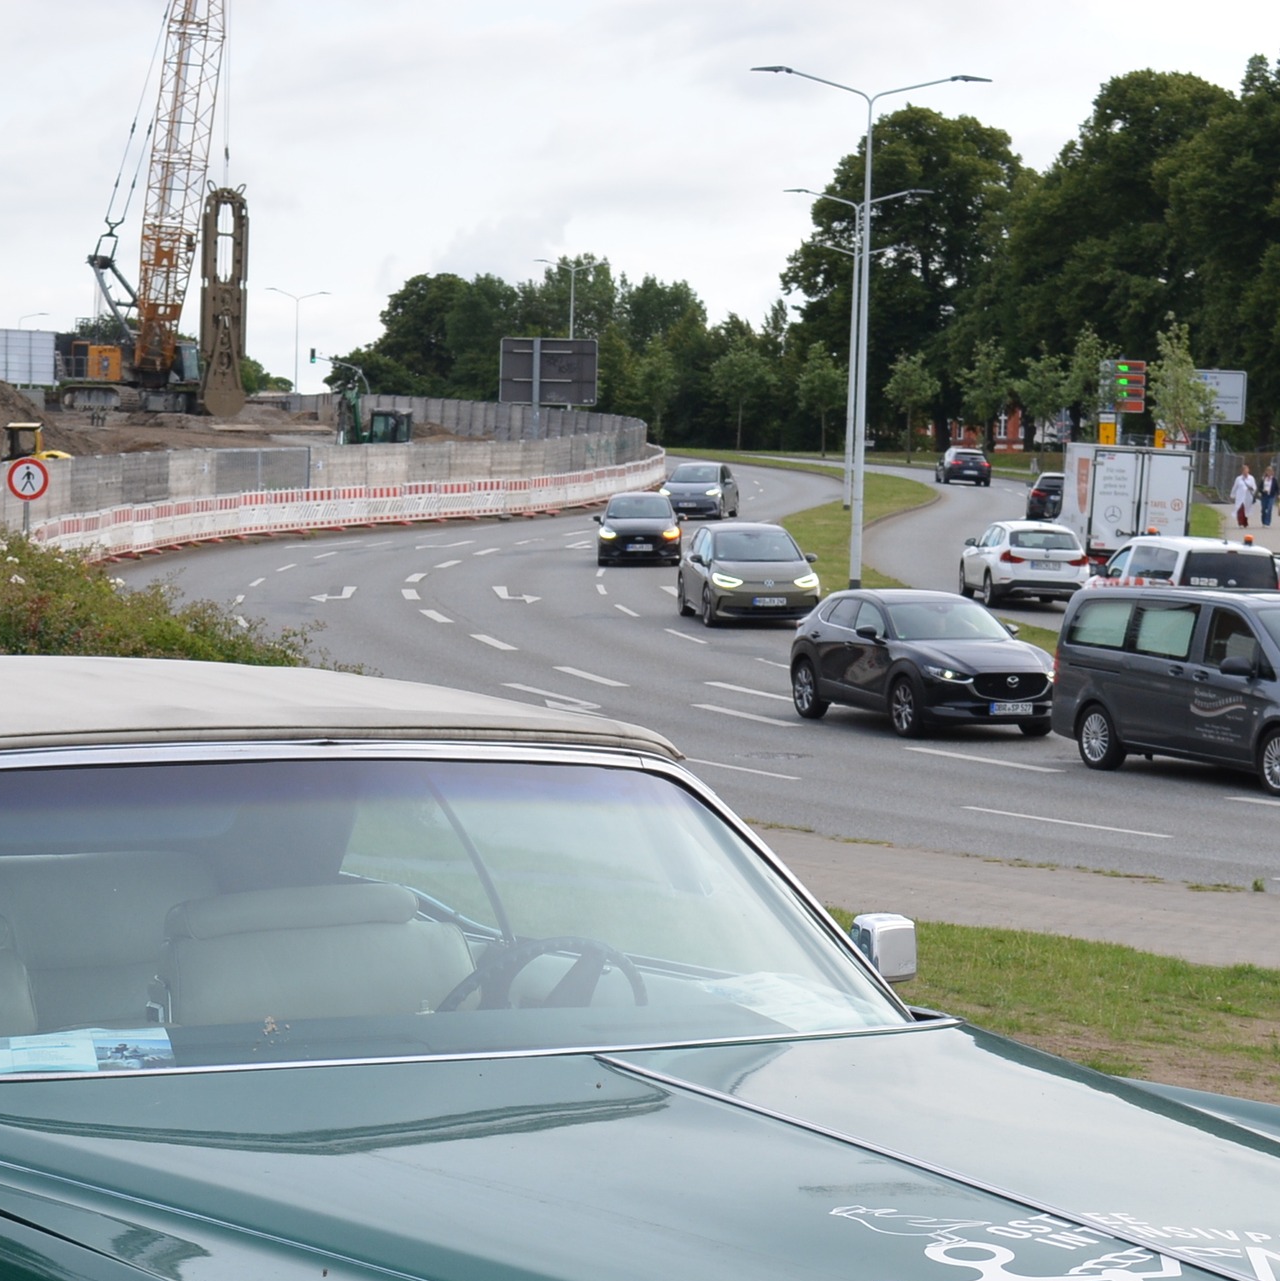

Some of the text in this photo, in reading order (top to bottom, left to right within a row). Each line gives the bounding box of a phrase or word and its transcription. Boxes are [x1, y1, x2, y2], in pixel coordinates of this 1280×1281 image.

[1150, 500, 1168, 509] TAFEL
[1020, 703, 1032, 712] 527
[986, 1212, 1150, 1240] OSTEE
